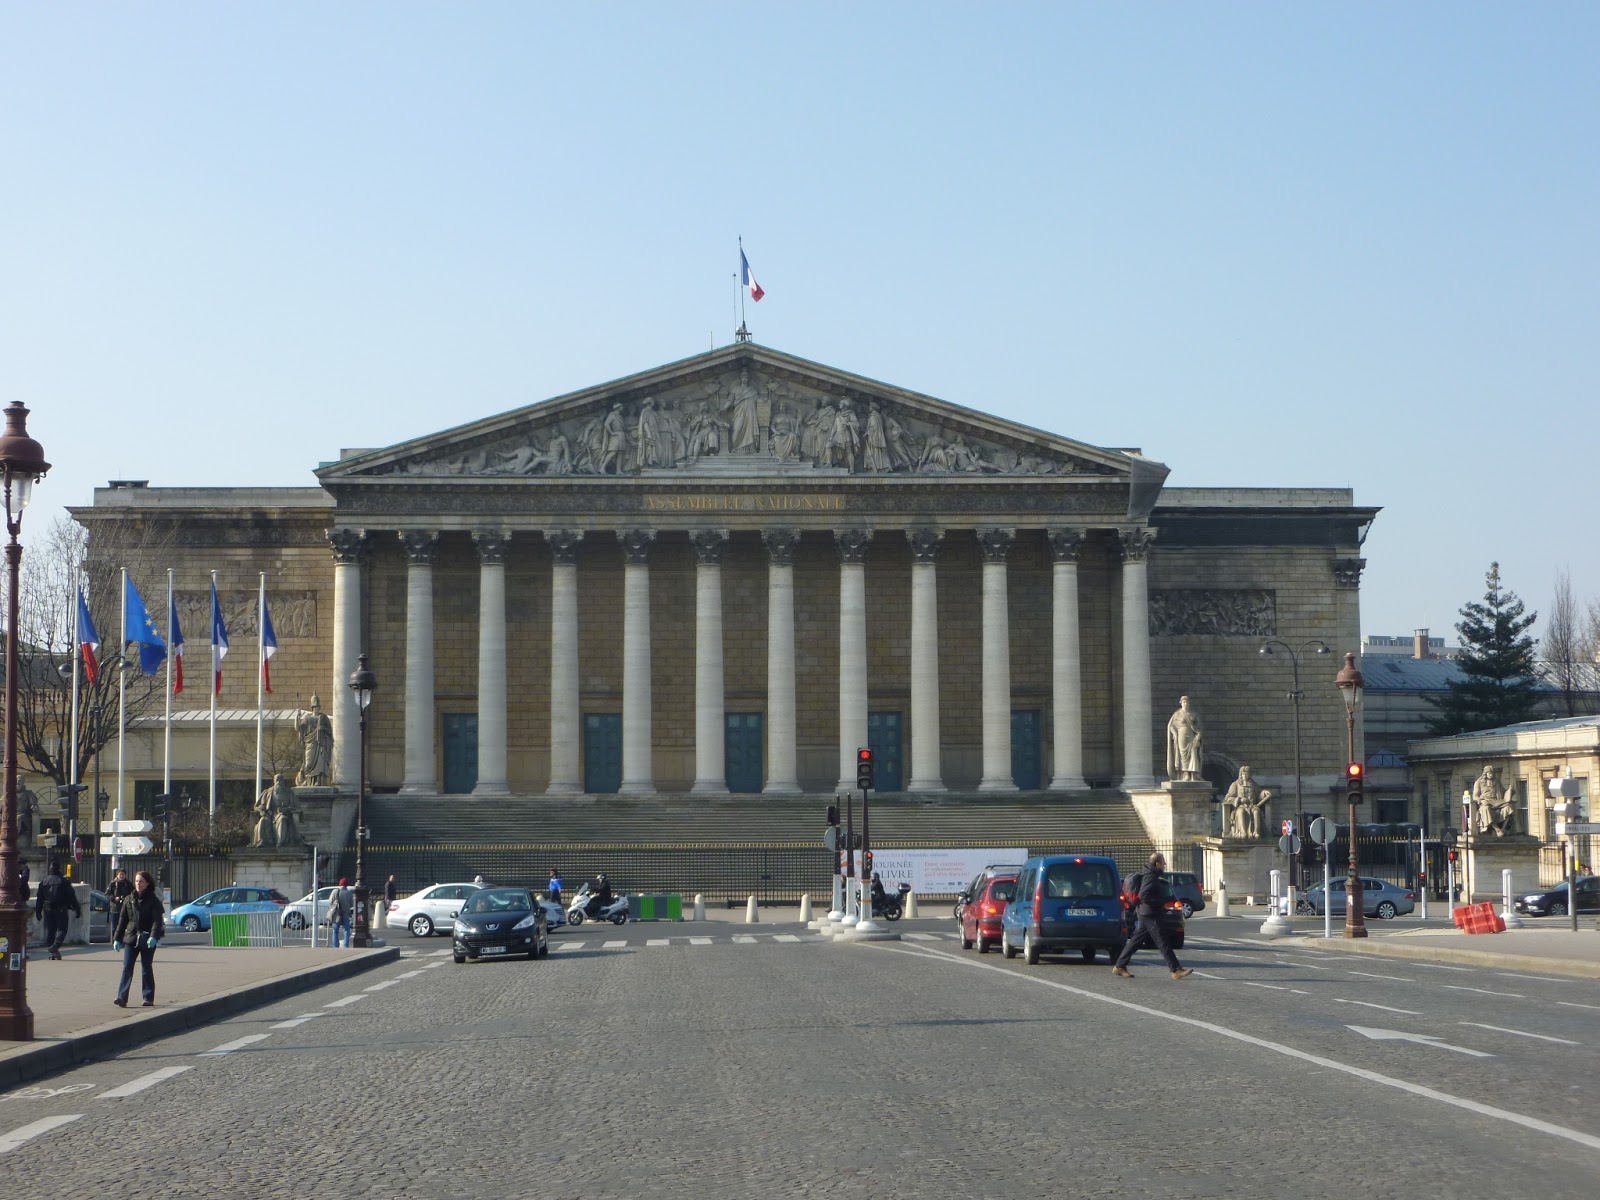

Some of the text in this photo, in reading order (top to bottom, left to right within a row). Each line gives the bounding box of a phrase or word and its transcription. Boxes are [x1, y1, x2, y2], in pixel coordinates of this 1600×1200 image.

[754, 496, 845, 509] NATIONALE
[873, 860, 913, 869] JOURNÉE
[881, 870, 913, 878] LIVRE
